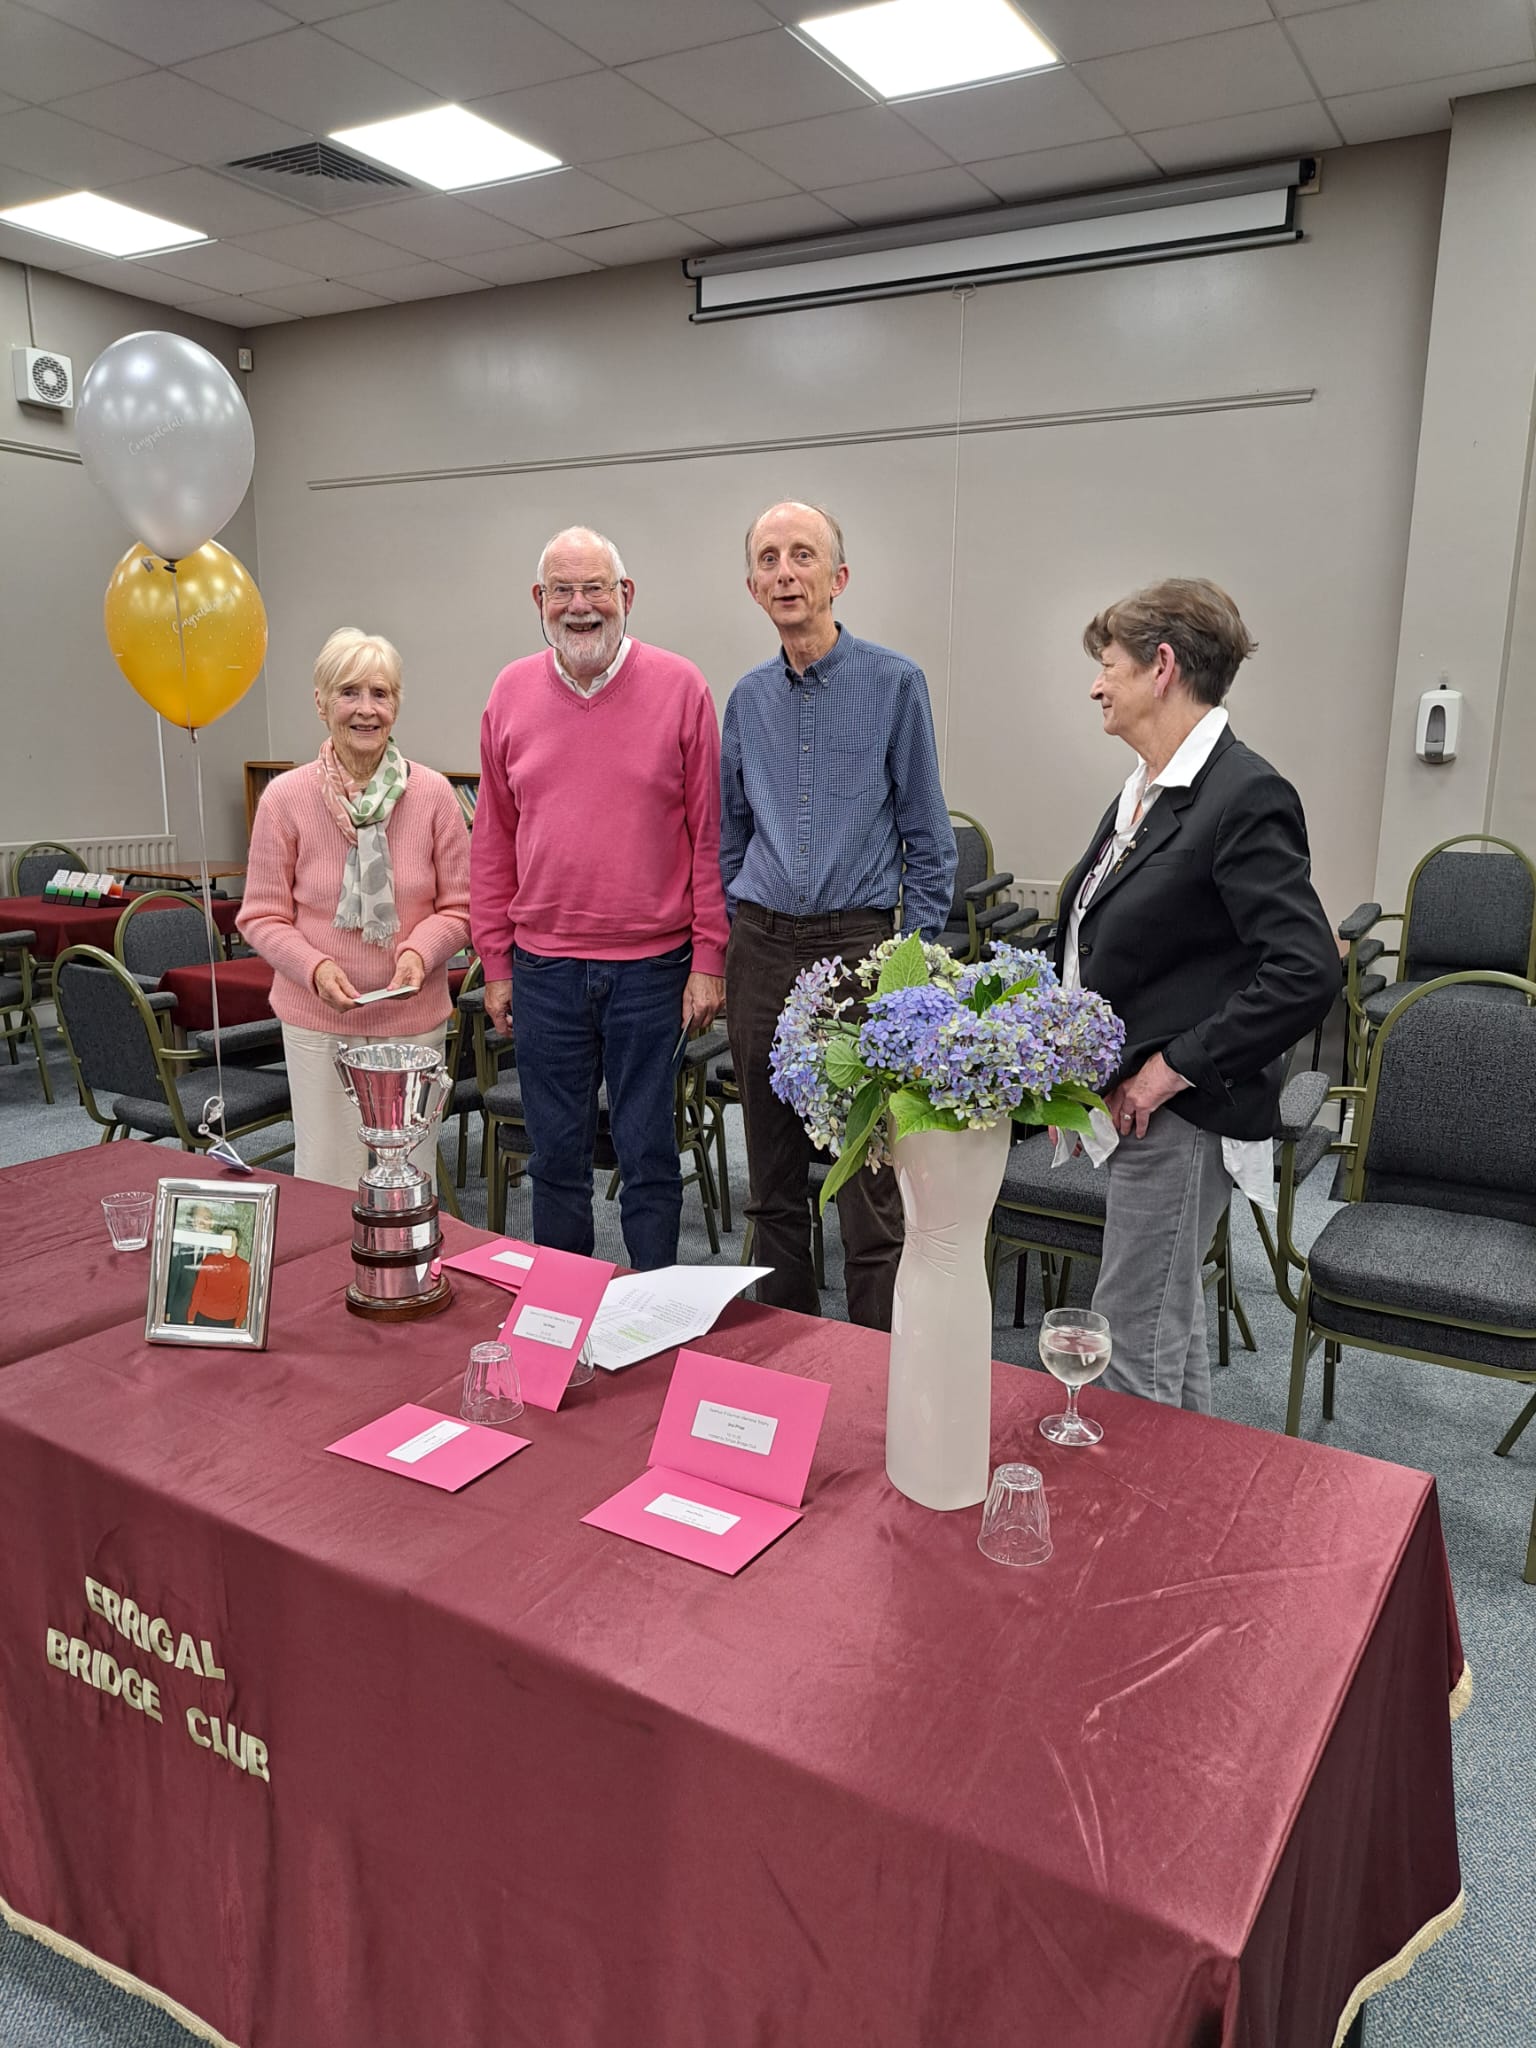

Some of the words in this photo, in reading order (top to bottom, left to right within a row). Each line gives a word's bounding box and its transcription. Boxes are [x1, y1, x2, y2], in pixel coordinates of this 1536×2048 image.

[85, 1575, 225, 1681] ERRIGAL
[46, 1627, 163, 1724] BRIDGE
[186, 1706, 270, 1783] CLUB
